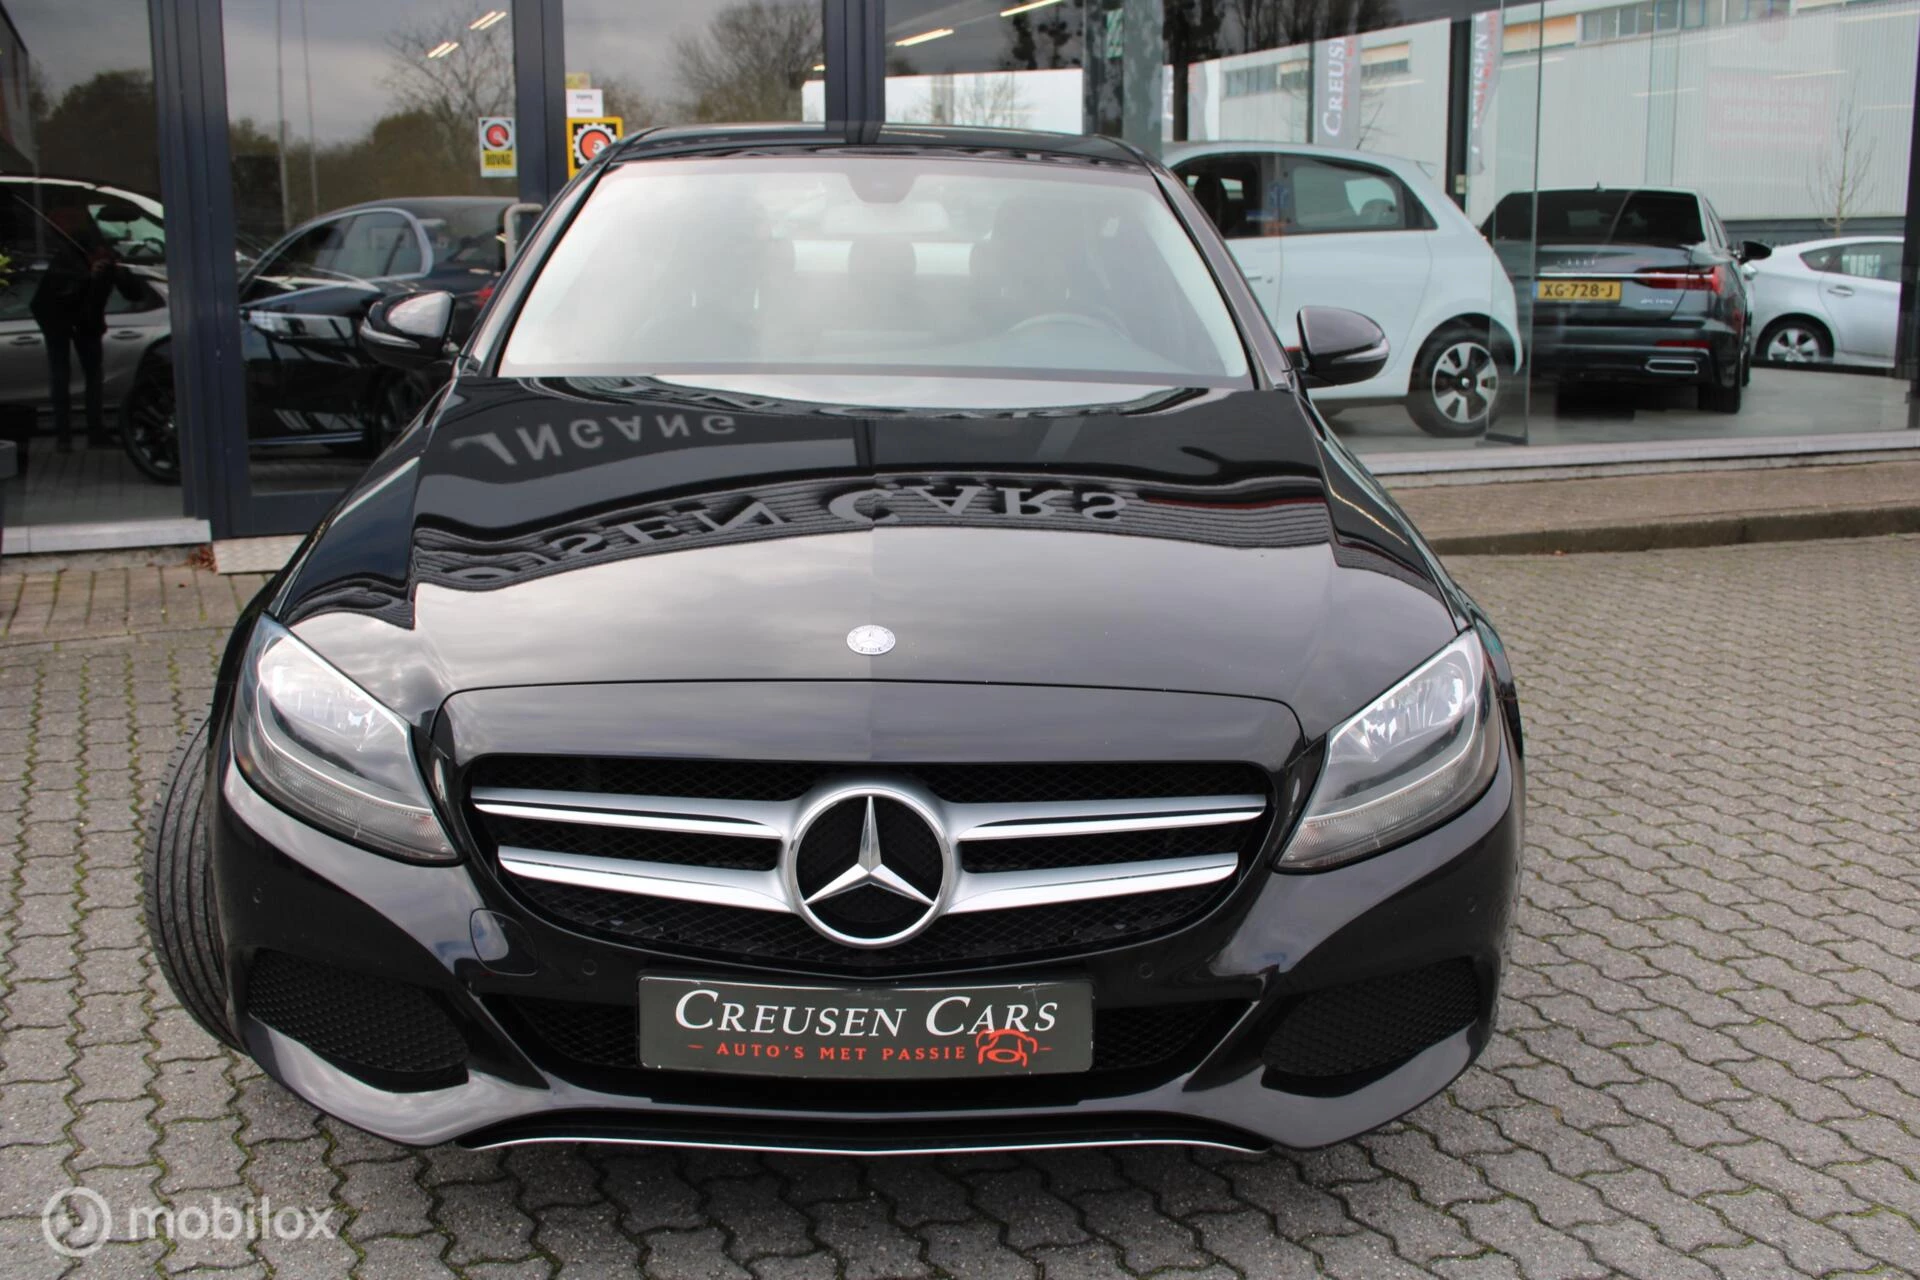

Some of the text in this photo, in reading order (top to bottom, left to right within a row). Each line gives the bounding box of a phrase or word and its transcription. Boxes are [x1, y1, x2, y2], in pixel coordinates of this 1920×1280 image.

[1544, 283, 1614, 297] XG-728-J
[675, 989, 1058, 1037] CREUSEN CARS
[716, 1042, 966, 1061] AUTO'S MET PASSIE
